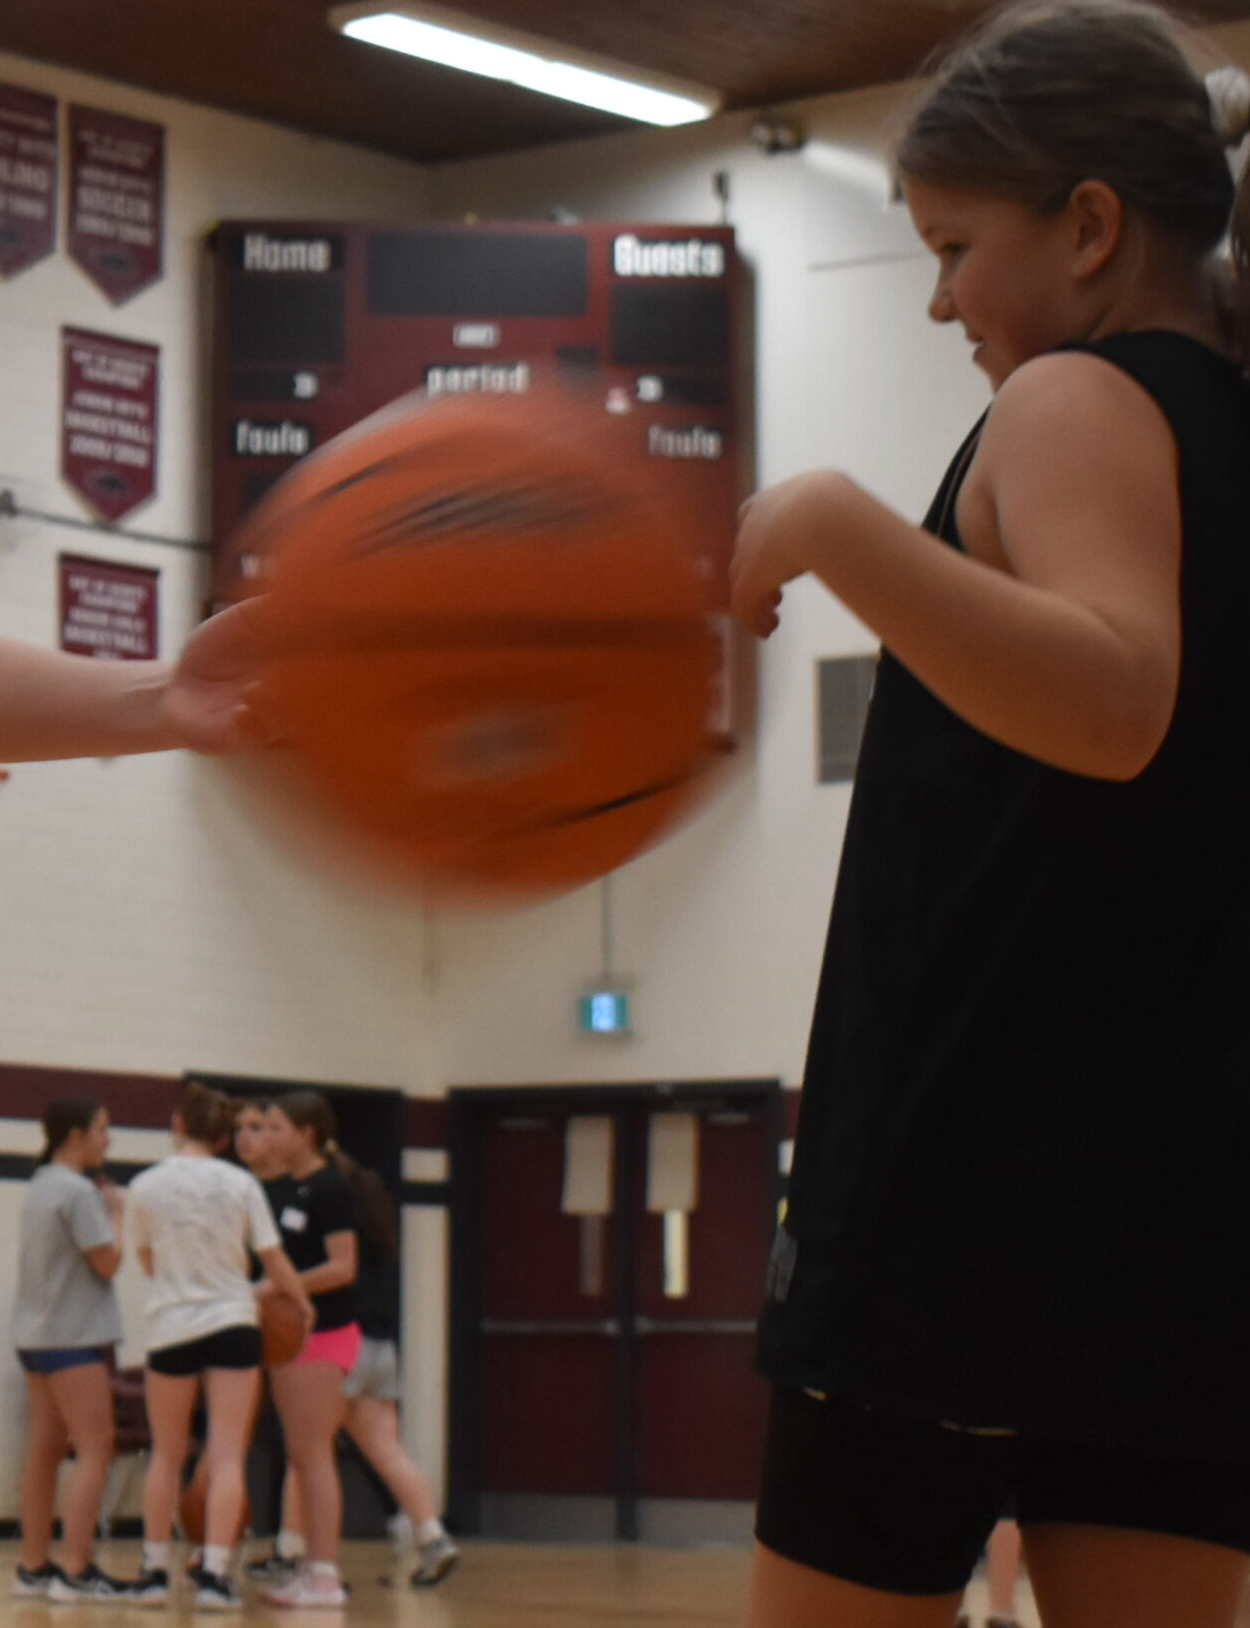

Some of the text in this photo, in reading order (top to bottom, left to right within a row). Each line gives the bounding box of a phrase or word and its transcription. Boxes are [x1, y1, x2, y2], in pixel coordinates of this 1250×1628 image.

[243, 234, 725, 276] Home Guests
[426, 361, 530, 394] period
[236, 420, 309, 455] fouls
